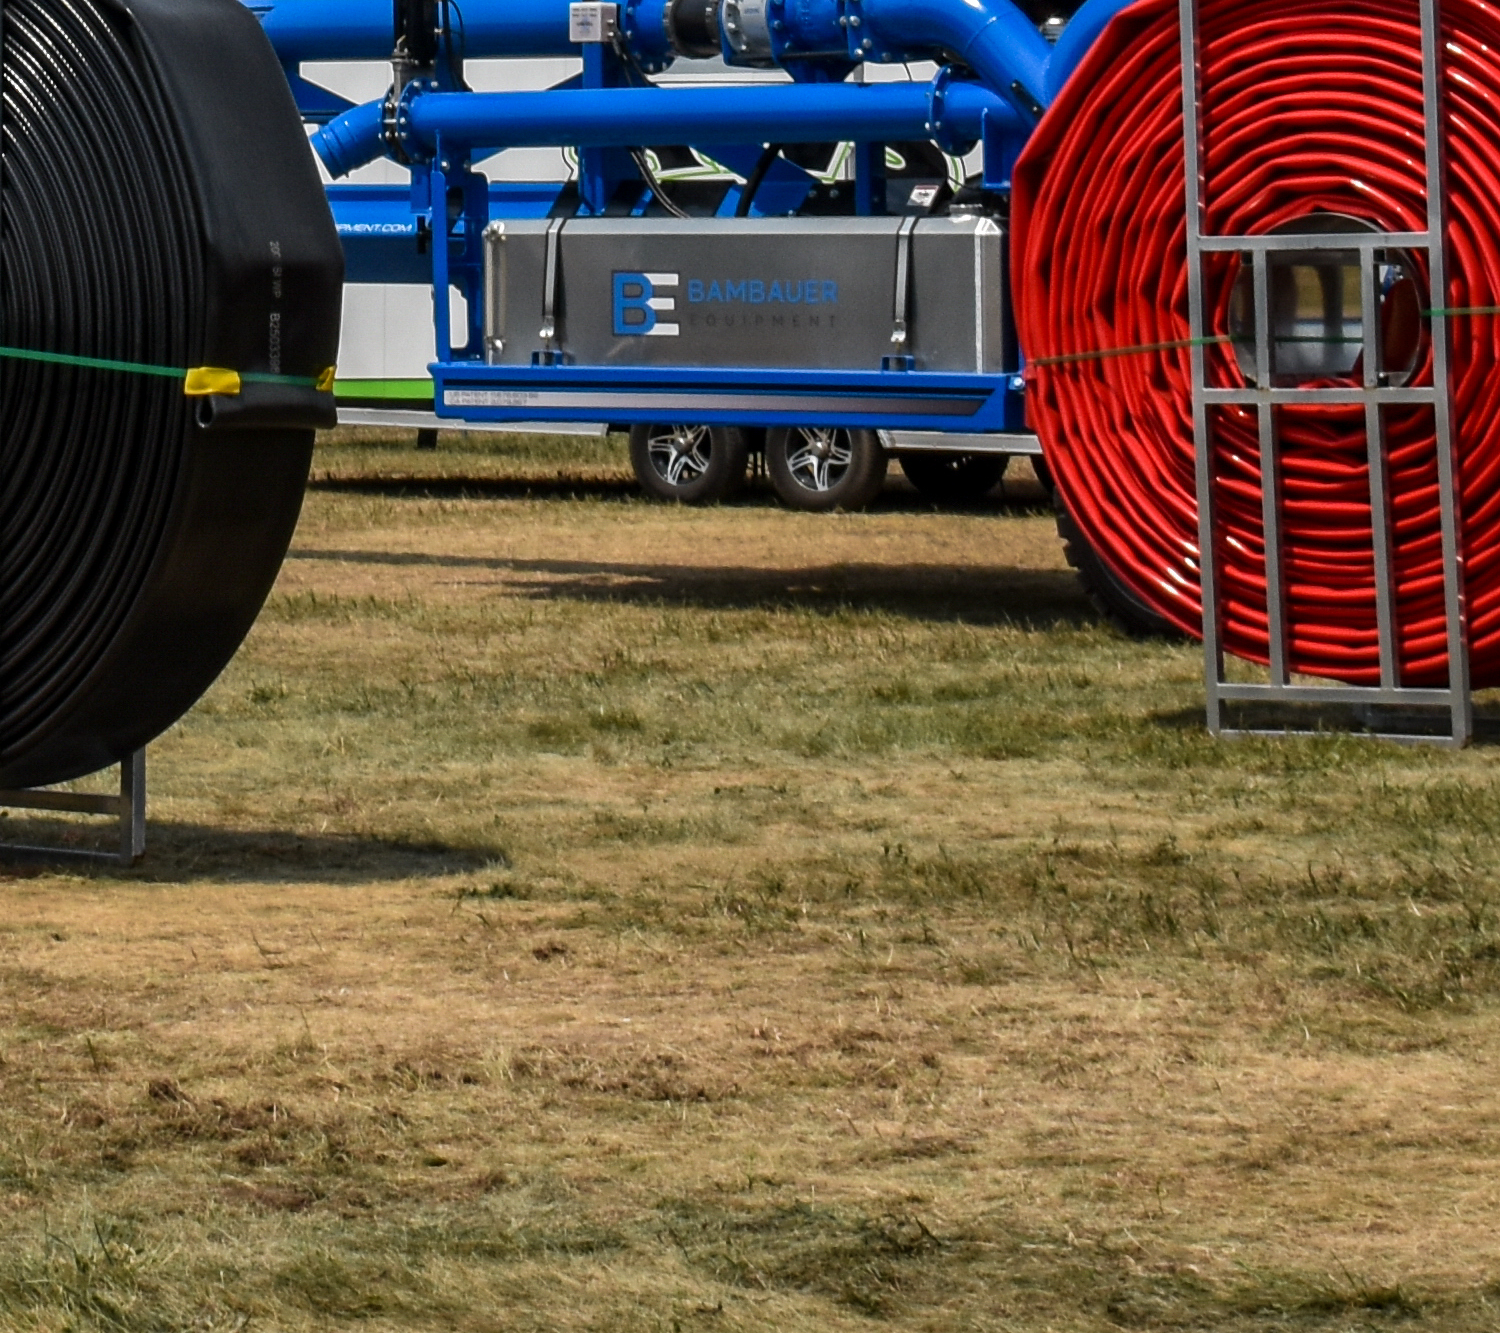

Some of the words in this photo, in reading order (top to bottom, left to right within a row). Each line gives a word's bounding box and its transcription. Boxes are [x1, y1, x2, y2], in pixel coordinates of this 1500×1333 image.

[612, 270, 680, 336] BE
[687, 279, 839, 304] BAMBAUER
[687, 313, 837, 328] EQUIPMENT
